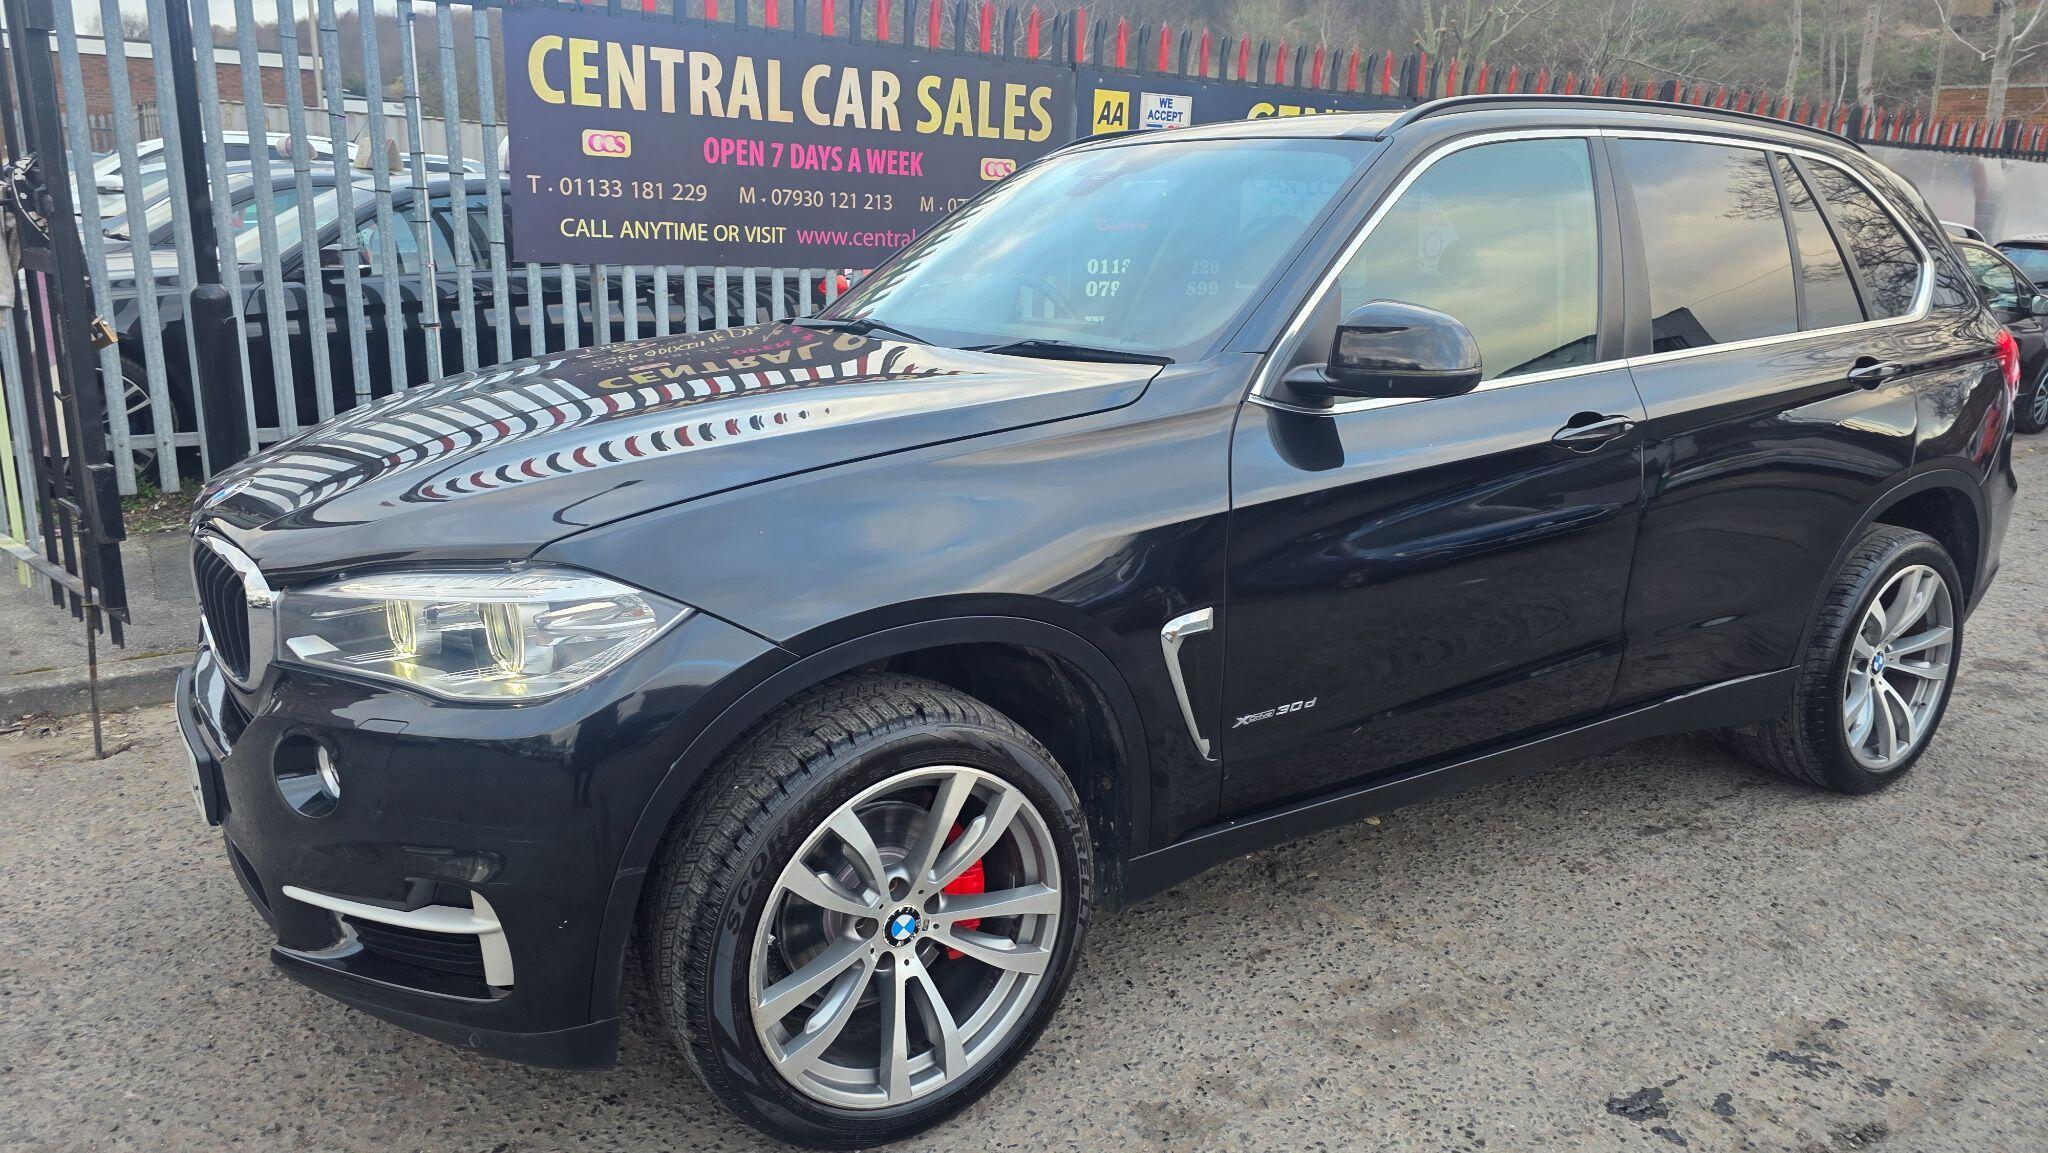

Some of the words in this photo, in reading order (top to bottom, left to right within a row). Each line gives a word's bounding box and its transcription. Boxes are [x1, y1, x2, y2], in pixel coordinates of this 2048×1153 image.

[527, 34, 794, 123] CENTRAL
[801, 63, 902, 132] CAR
[915, 75, 1053, 142] SALES
[1096, 100, 1124, 126] AA
[1147, 109, 1184, 122] ACCEPT
[1159, 97, 1174, 109] WE
[588, 133, 627, 154] CCS
[703, 136, 764, 167] OPEN
[770, 142, 784, 168] 7
[790, 143, 843, 172] DAYS
[847, 147, 862, 173] A
[866, 149, 925, 177] WEEK
[559, 176, 623, 199] 01133
[631, 181, 664, 200] 181
[670, 183, 708, 202] 229
[771, 188, 824, 209] 07930
[830, 191, 857, 210] 121
[863, 193, 893, 211] 213
[560, 217, 614, 239] CALL
[620, 220, 709, 242] ANYTIME
[713, 224, 740, 243] OR
[745, 226, 787, 244] VISIT
